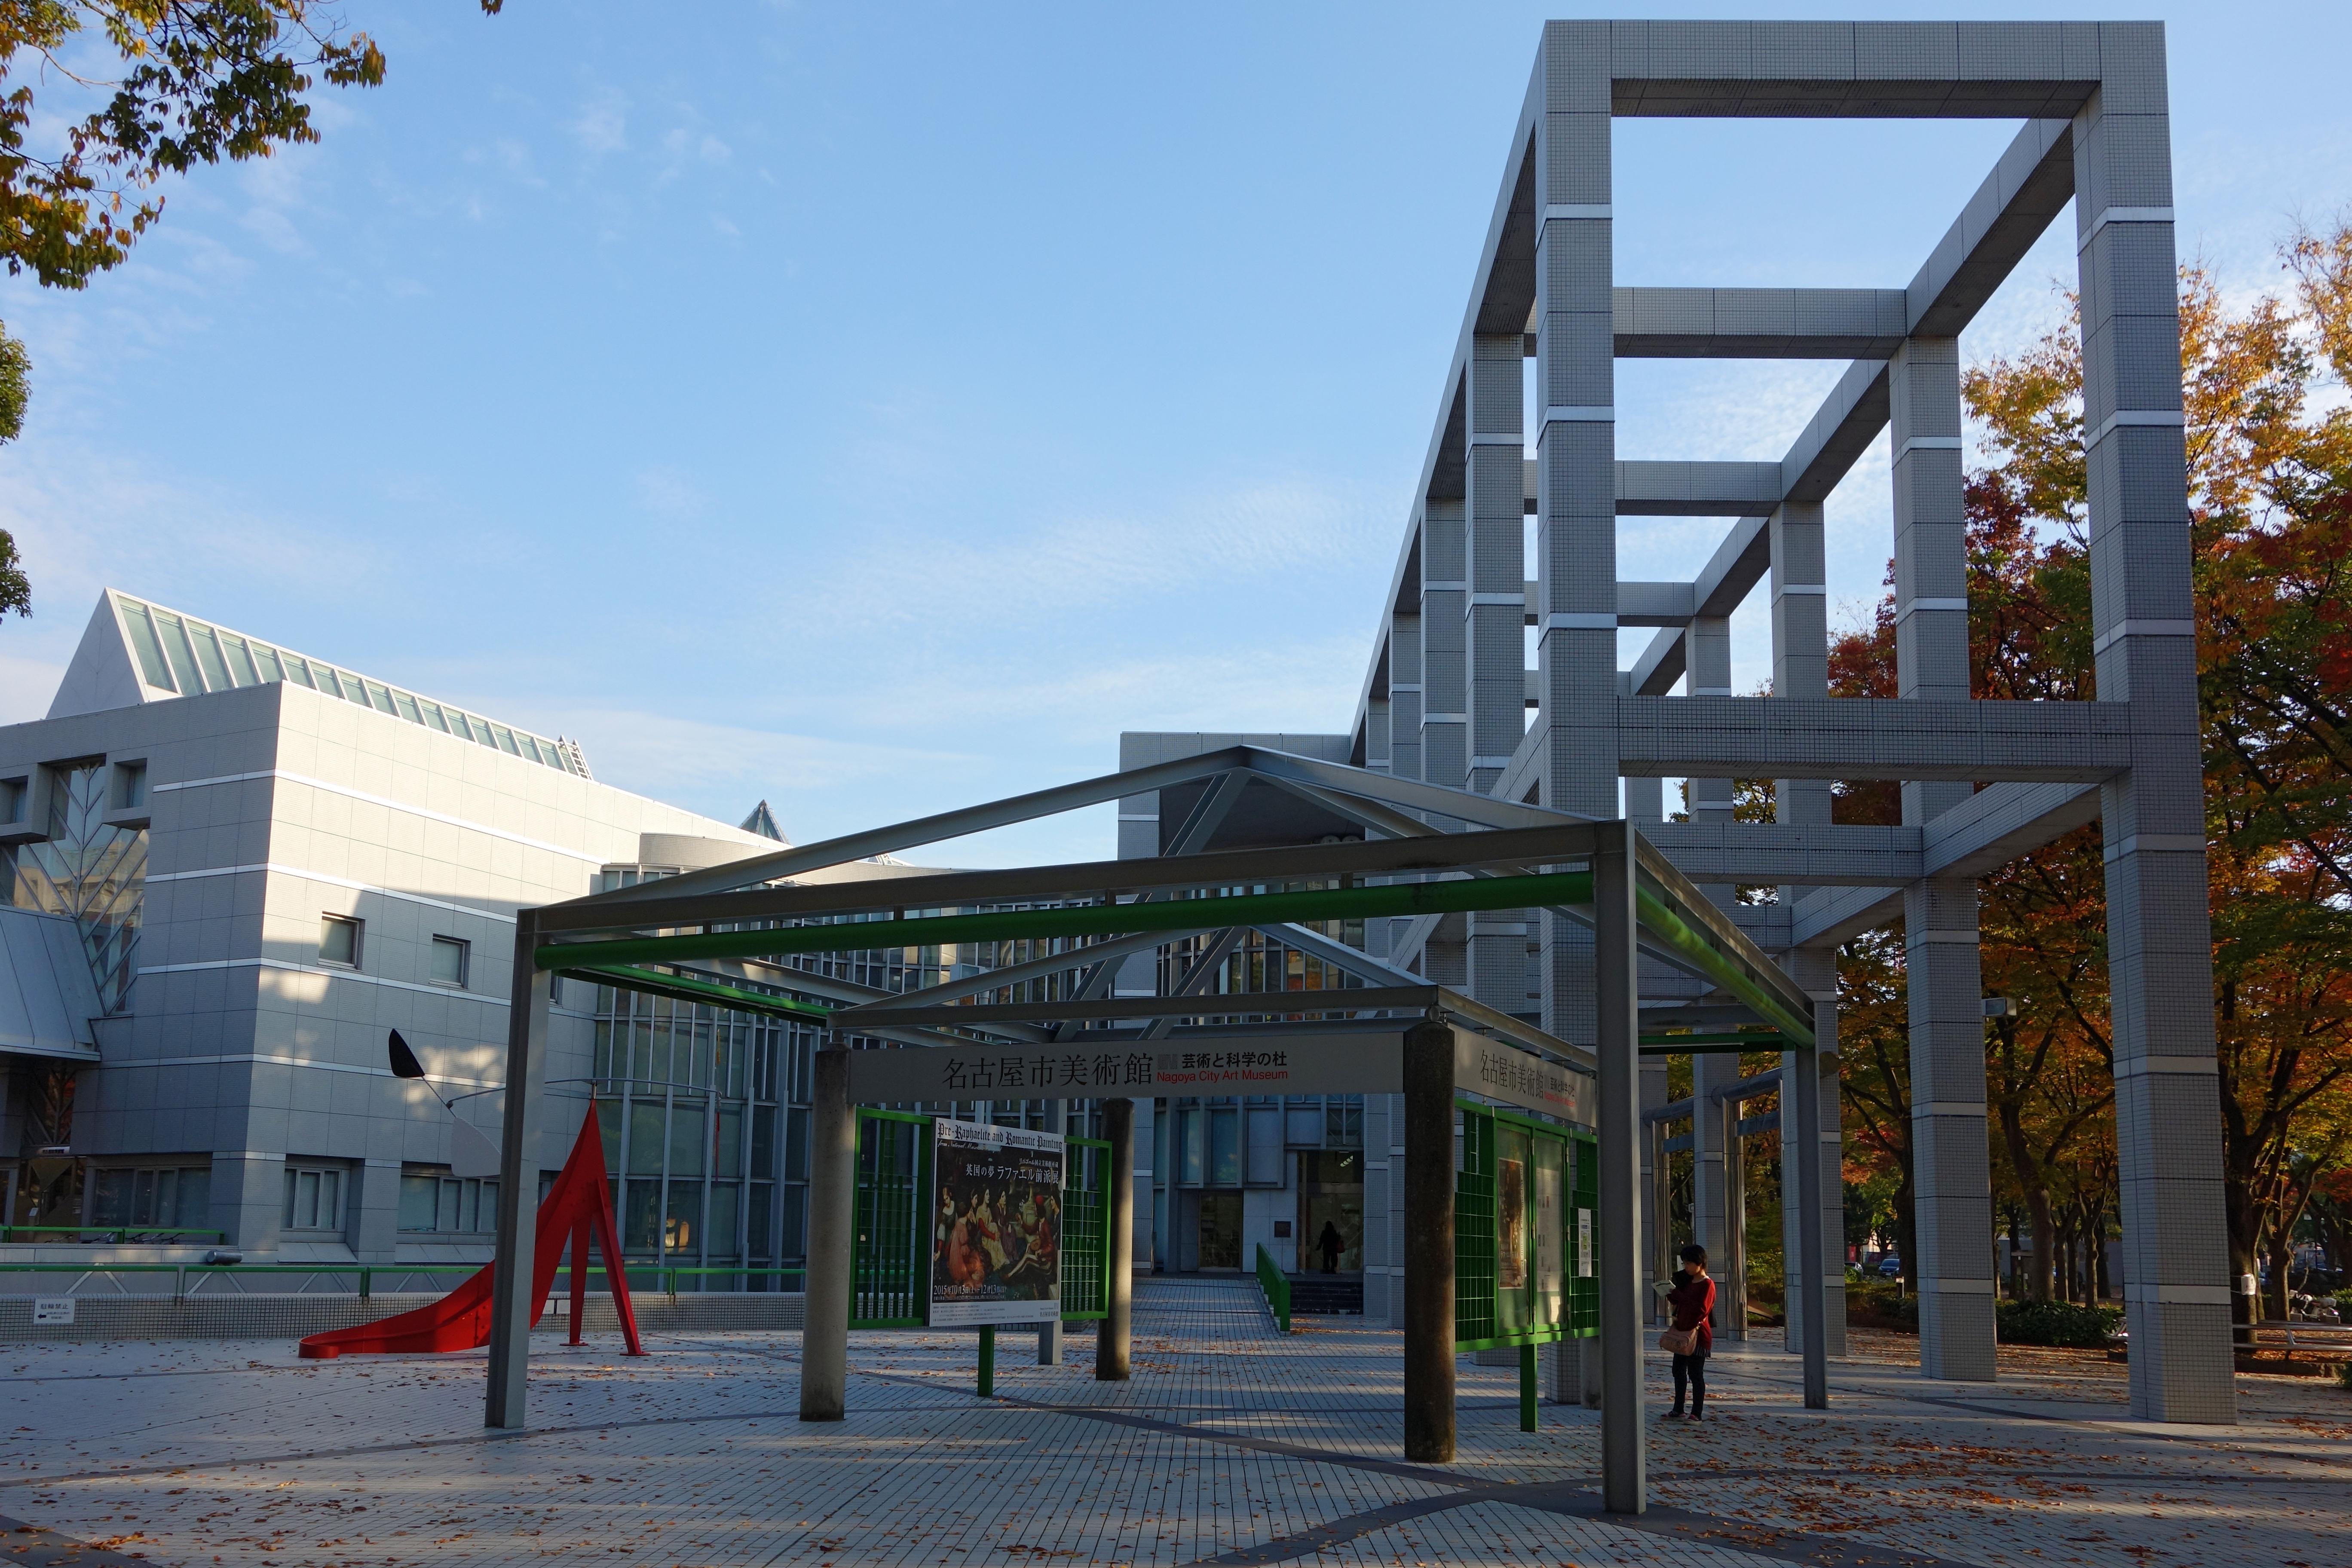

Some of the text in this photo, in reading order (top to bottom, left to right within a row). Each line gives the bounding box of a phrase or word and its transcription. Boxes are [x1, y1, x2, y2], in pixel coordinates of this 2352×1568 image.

[943, 1051, 1153, 1090] 名古屋市美術館
[1182, 1051, 1287, 1069] 芸術と科学の杜
[1157, 1069, 1288, 1084] Nagoya City Art Museum
[1480, 1049, 1544, 1099] 名古屋市美術館
[938, 1122, 1063, 1152] Pre-Raphaelite and Romantic Painting
[966, 1163, 1059, 1185] 英国の夢 ラファエル前派展
